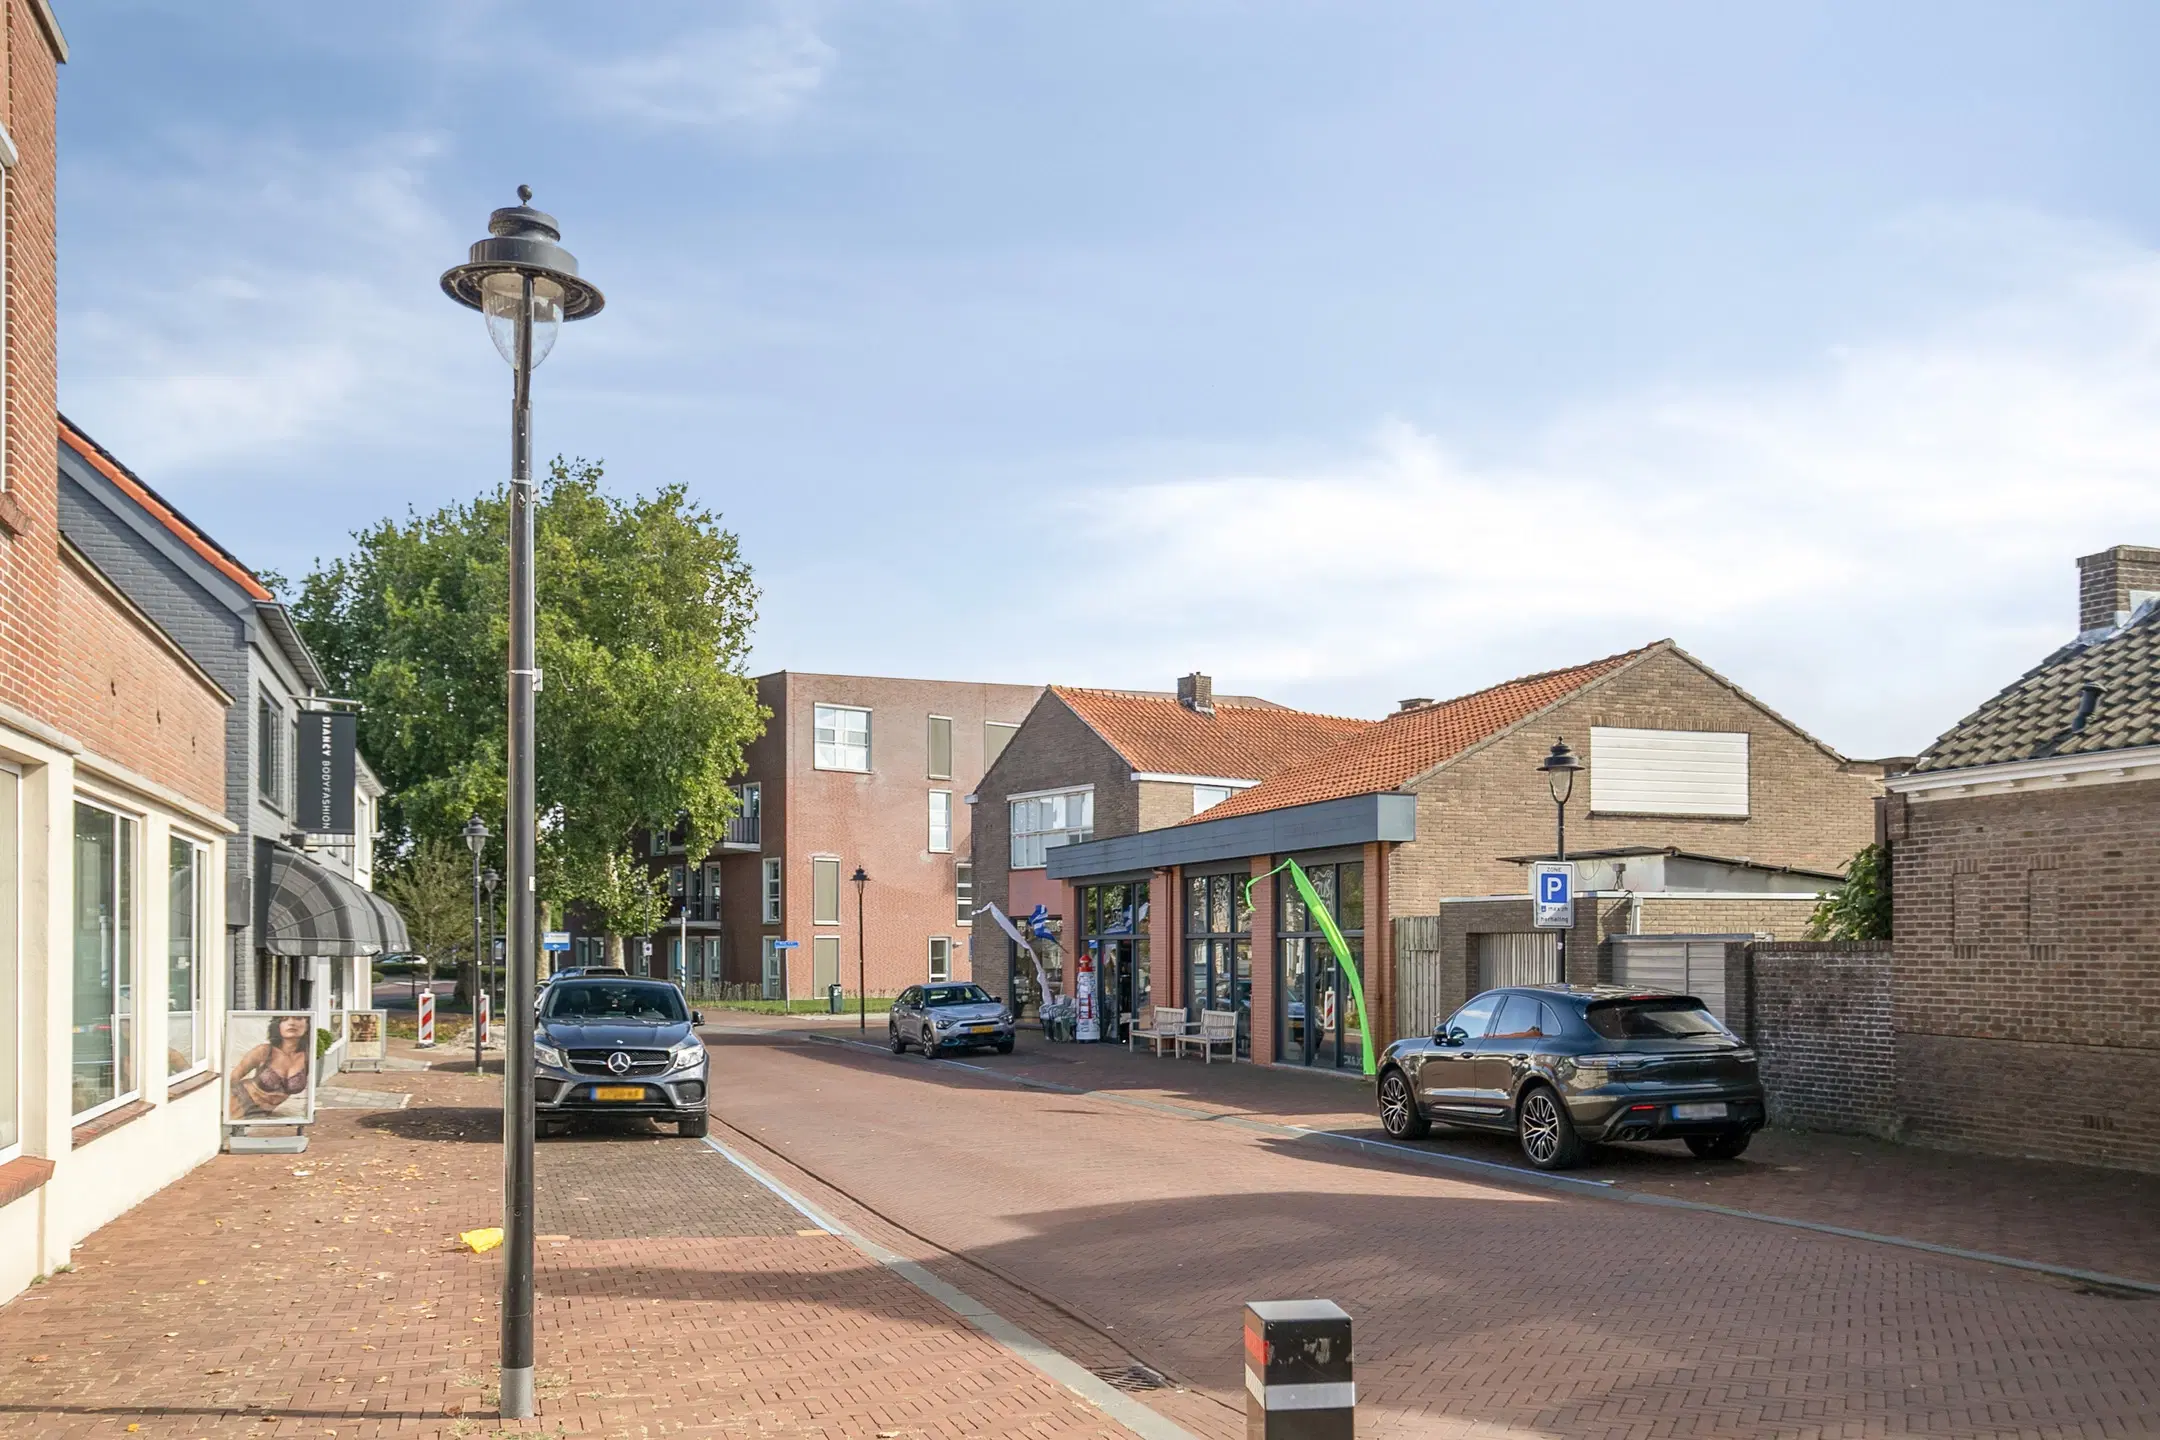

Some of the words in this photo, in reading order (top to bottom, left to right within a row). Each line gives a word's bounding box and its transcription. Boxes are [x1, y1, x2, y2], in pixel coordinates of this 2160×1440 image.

[322, 716, 332, 756] DIANCY
[322, 760, 332, 829] BODYFASHION
[1548, 877, 1562, 900] P
